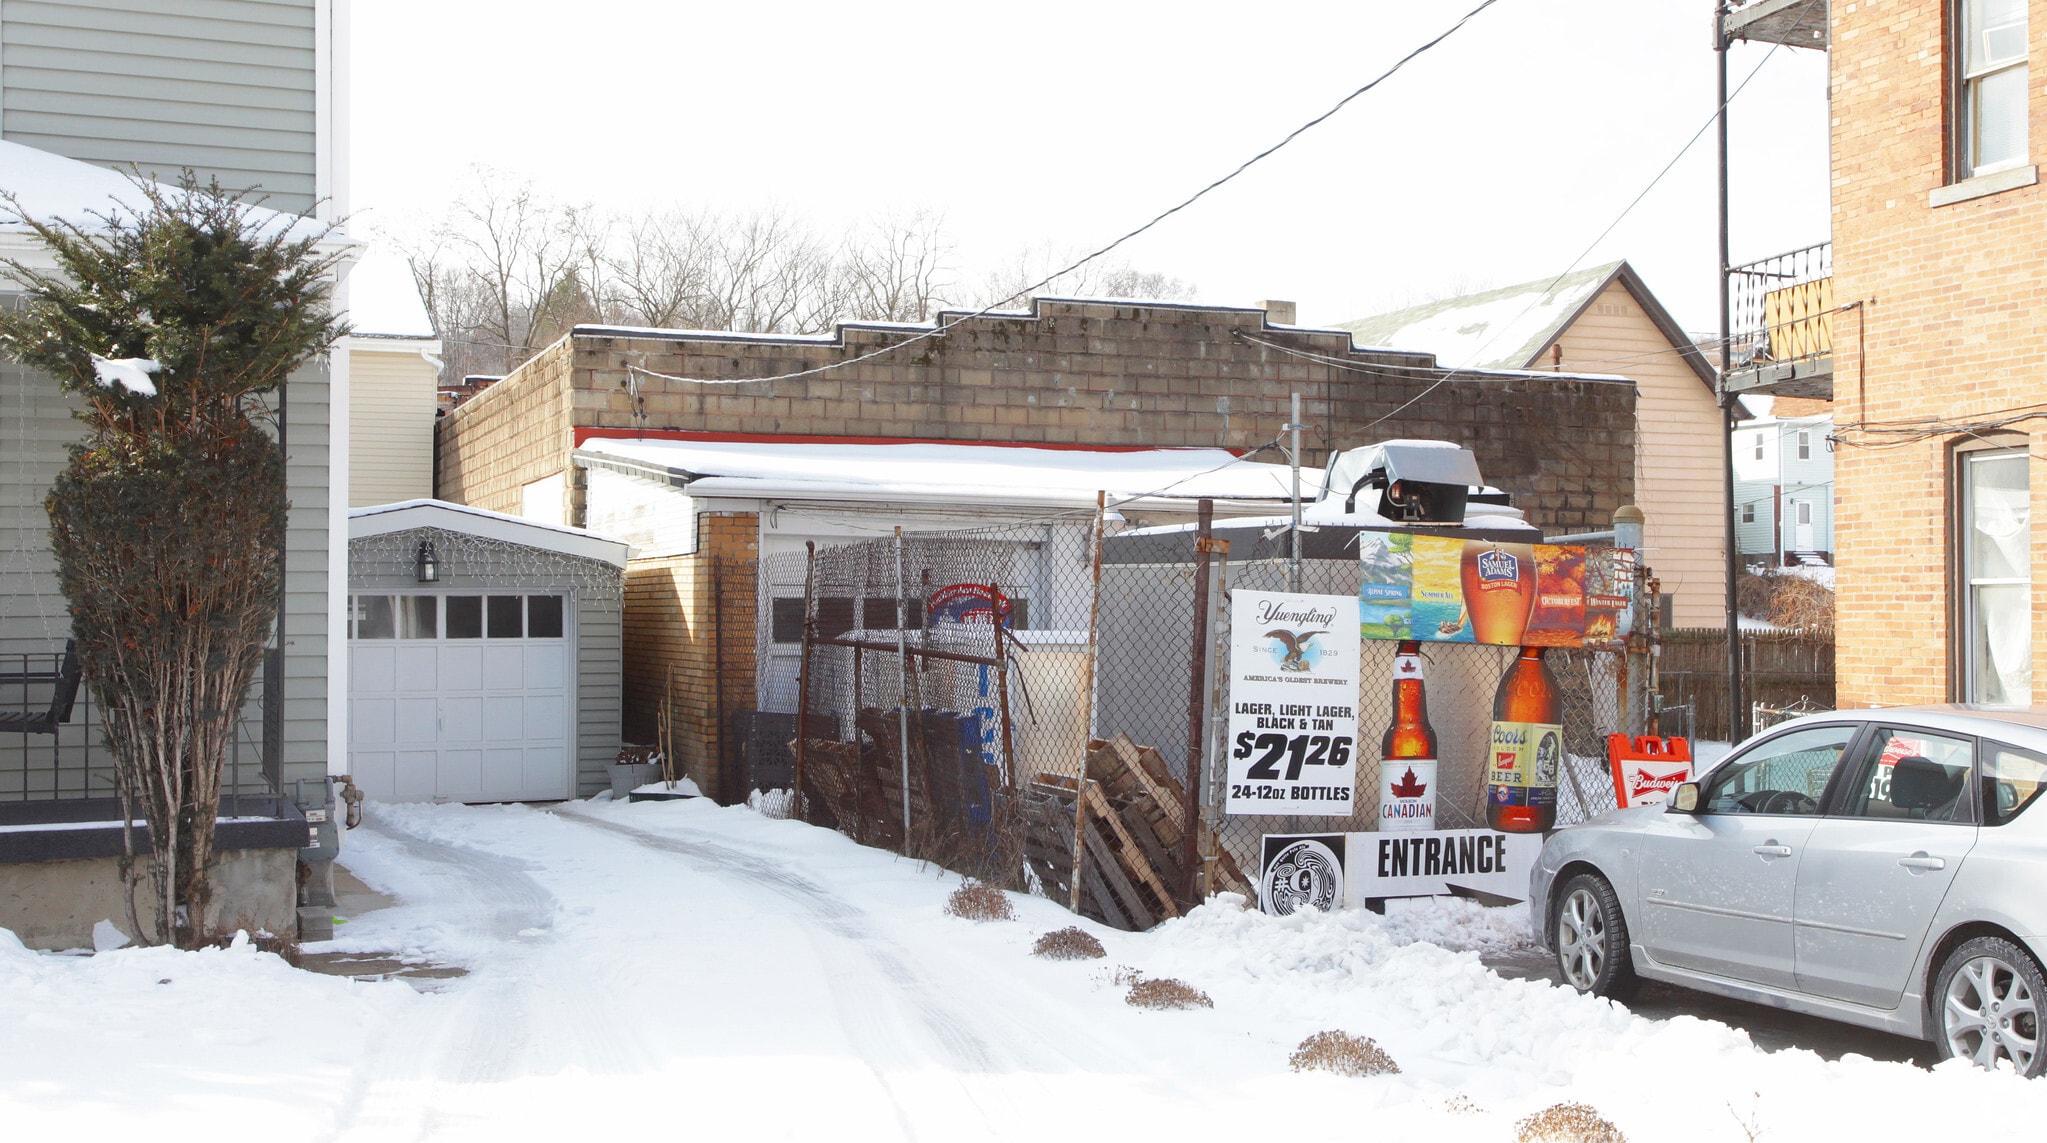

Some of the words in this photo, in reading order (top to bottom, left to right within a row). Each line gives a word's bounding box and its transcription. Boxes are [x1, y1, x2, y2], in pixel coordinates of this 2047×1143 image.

[1482, 558, 1515, 570] SAMUEL
[1485, 567, 1513, 578] ADAMS
[1481, 581, 1500, 590] BOSTON
[1501, 581, 1518, 589] LAGER
[1385, 589, 1403, 597] SPRING
[1421, 590, 1444, 599] SUMMER
[1256, 599, 1338, 629] Yuengling
[1252, 645, 1278, 654] SINCE
[1319, 649, 1339, 657] 1829
[1243, 674, 1284, 682] AMERICA'S
[1284, 676, 1312, 684] OLDEST
[1235, 702, 1276, 718] LAGER,
[1280, 704, 1312, 717] LIGHT
[1316, 705, 1355, 721] LAGER,
[1256, 717, 1295, 730] BLACK
[1299, 719, 1308, 730] &
[1312, 719, 1334, 731] TAN
[1493, 724, 1529, 745] Coors
[1490, 771, 1523, 783] BEER
[1628, 774, 1685, 791] Budwei
[1290, 786, 1350, 801] BOTTLES
[1382, 803, 1433, 819] CANADIAN
[1378, 834, 1507, 878] ENTRANCE
